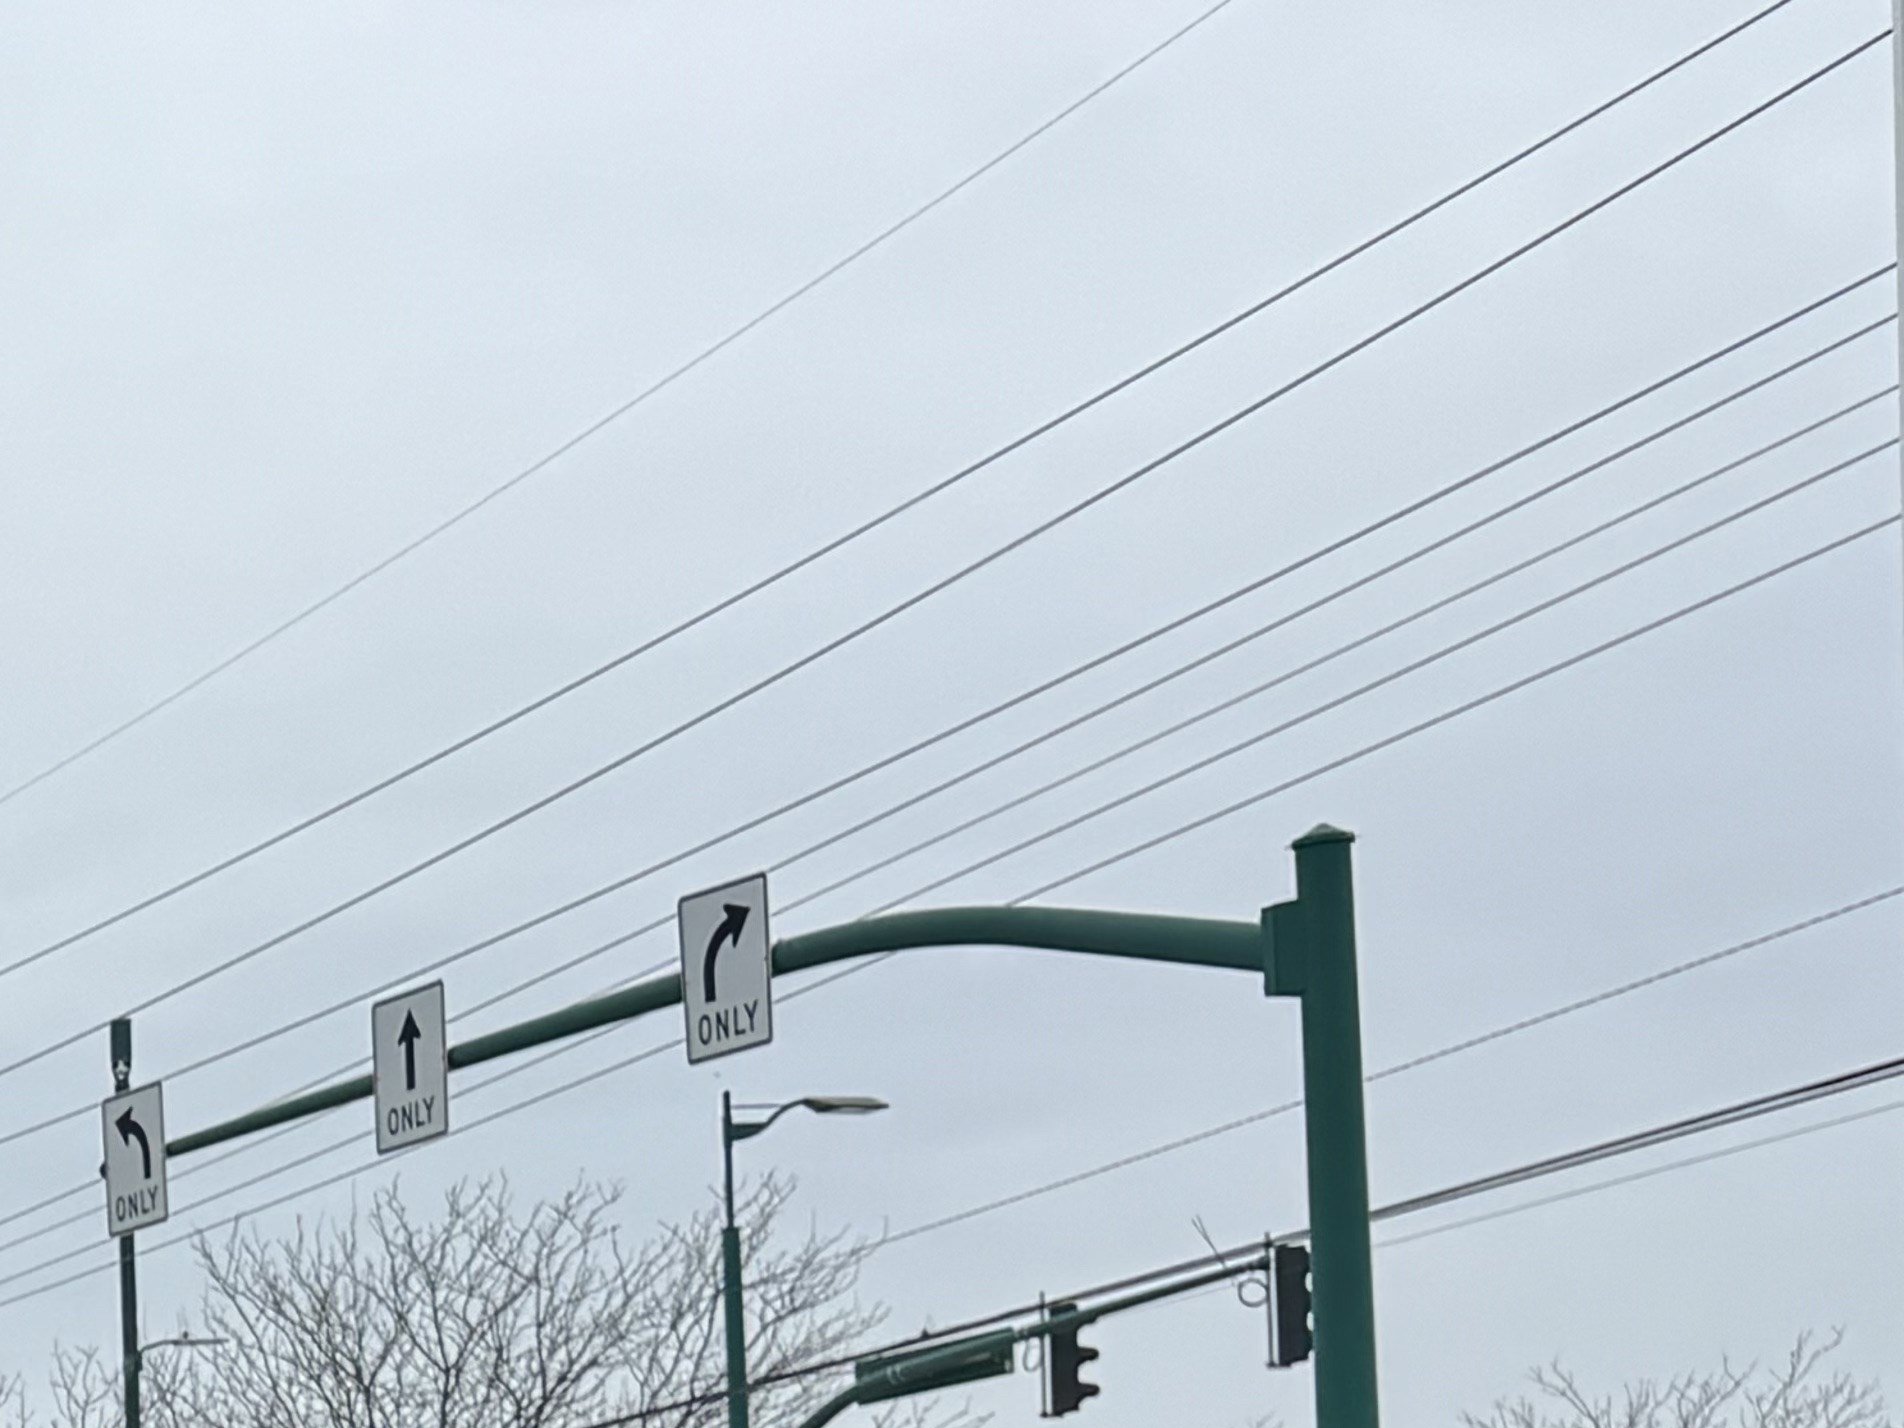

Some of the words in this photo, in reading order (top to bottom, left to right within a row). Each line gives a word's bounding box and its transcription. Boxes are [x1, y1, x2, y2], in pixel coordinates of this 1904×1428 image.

[699, 1000, 758, 1045] ONLY
[387, 1095, 435, 1136] ONLY
[115, 1184, 158, 1222] ONLY
